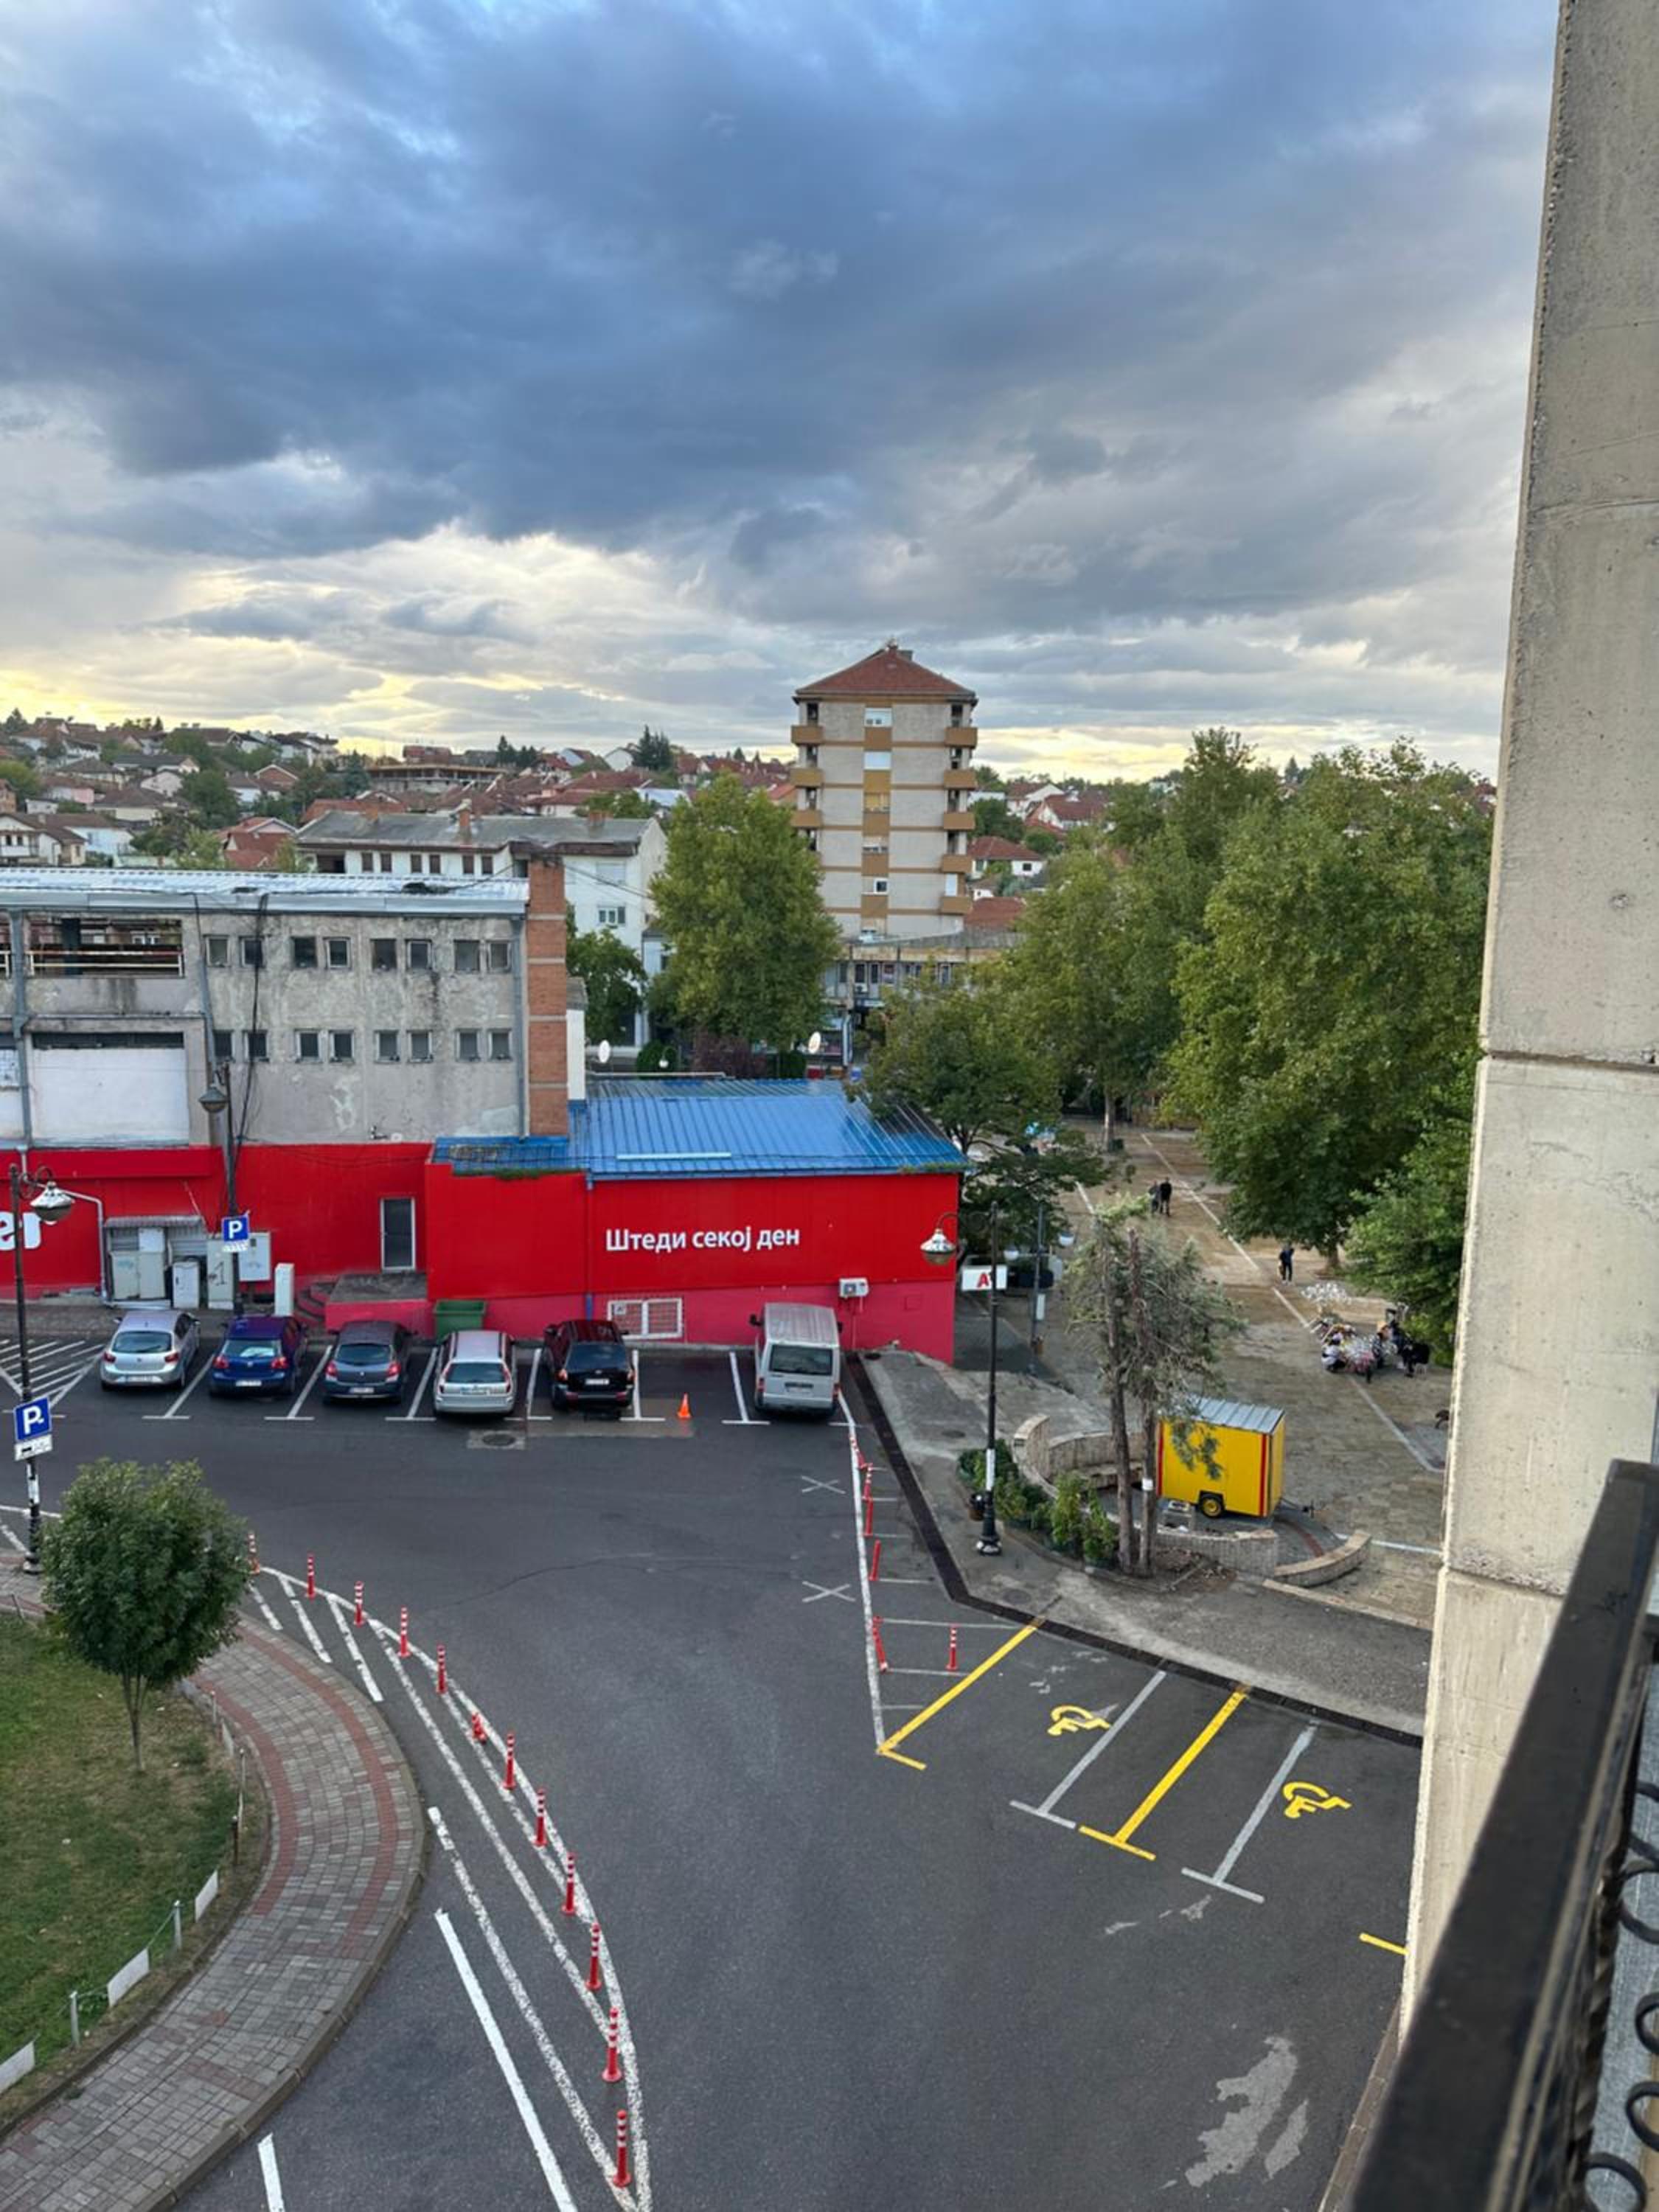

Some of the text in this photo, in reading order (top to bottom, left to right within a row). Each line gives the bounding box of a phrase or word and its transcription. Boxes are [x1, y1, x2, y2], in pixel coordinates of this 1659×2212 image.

[229, 1220, 243, 1239] P
[606, 1226, 800, 1253] Штеди секој ден
[22, 1405, 42, 1435] P
